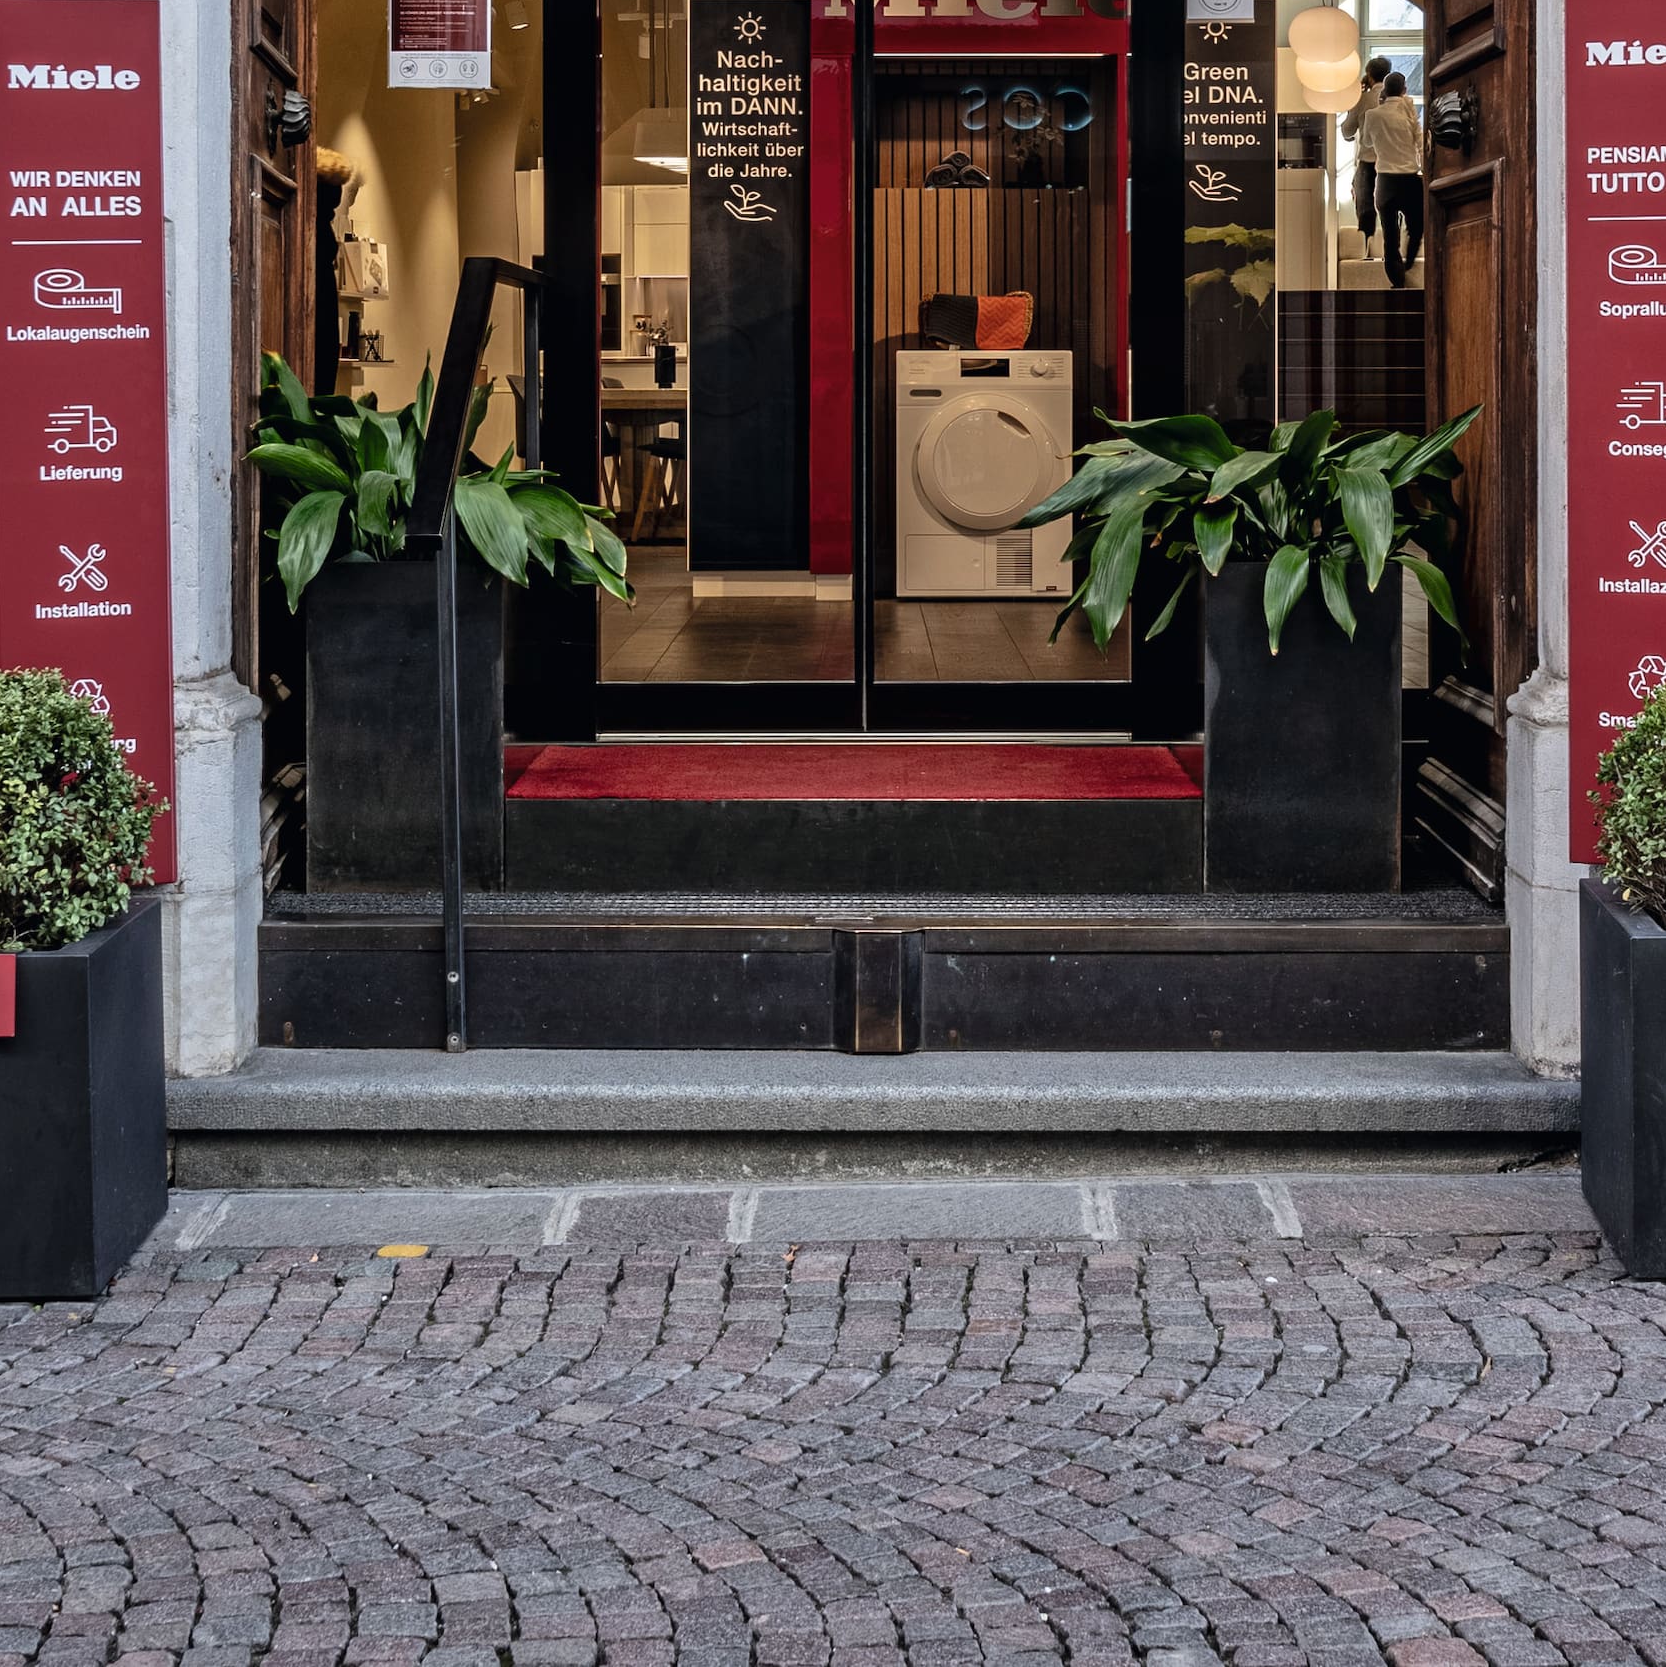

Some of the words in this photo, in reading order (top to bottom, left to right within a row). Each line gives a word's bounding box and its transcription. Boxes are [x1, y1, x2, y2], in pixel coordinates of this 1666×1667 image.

[718, 51, 782, 68] Nach-
[8, 65, 140, 89] Miele
[1185, 63, 1247, 80] Green
[700, 74, 801, 95] haltigkeit
[1185, 86, 1199, 103] el
[1209, 86, 1263, 103] DNA.
[697, 98, 721, 115] im
[732, 98, 802, 115] DANN.
[1184, 111, 1266, 124] nvenienti
[702, 122, 797, 135] Wirtschaft-
[1184, 131, 1195, 145] el
[1202, 132, 1260, 148] tempo.
[698, 143, 759, 156] lichkeit
[766, 143, 804, 156] über
[10, 171, 50, 187] WIR
[57, 171, 140, 187] DENKEN
[708, 164, 734, 177] die
[740, 164, 792, 177] Jahre.
[1587, 172, 1665, 193] TUTTO
[11, 197, 46, 216] AN
[62, 196, 141, 216] ALLES
[7, 324, 149, 343] Lokalaugenschein
[40, 466, 122, 481] Lieferung
[36, 601, 131, 618] Installation
